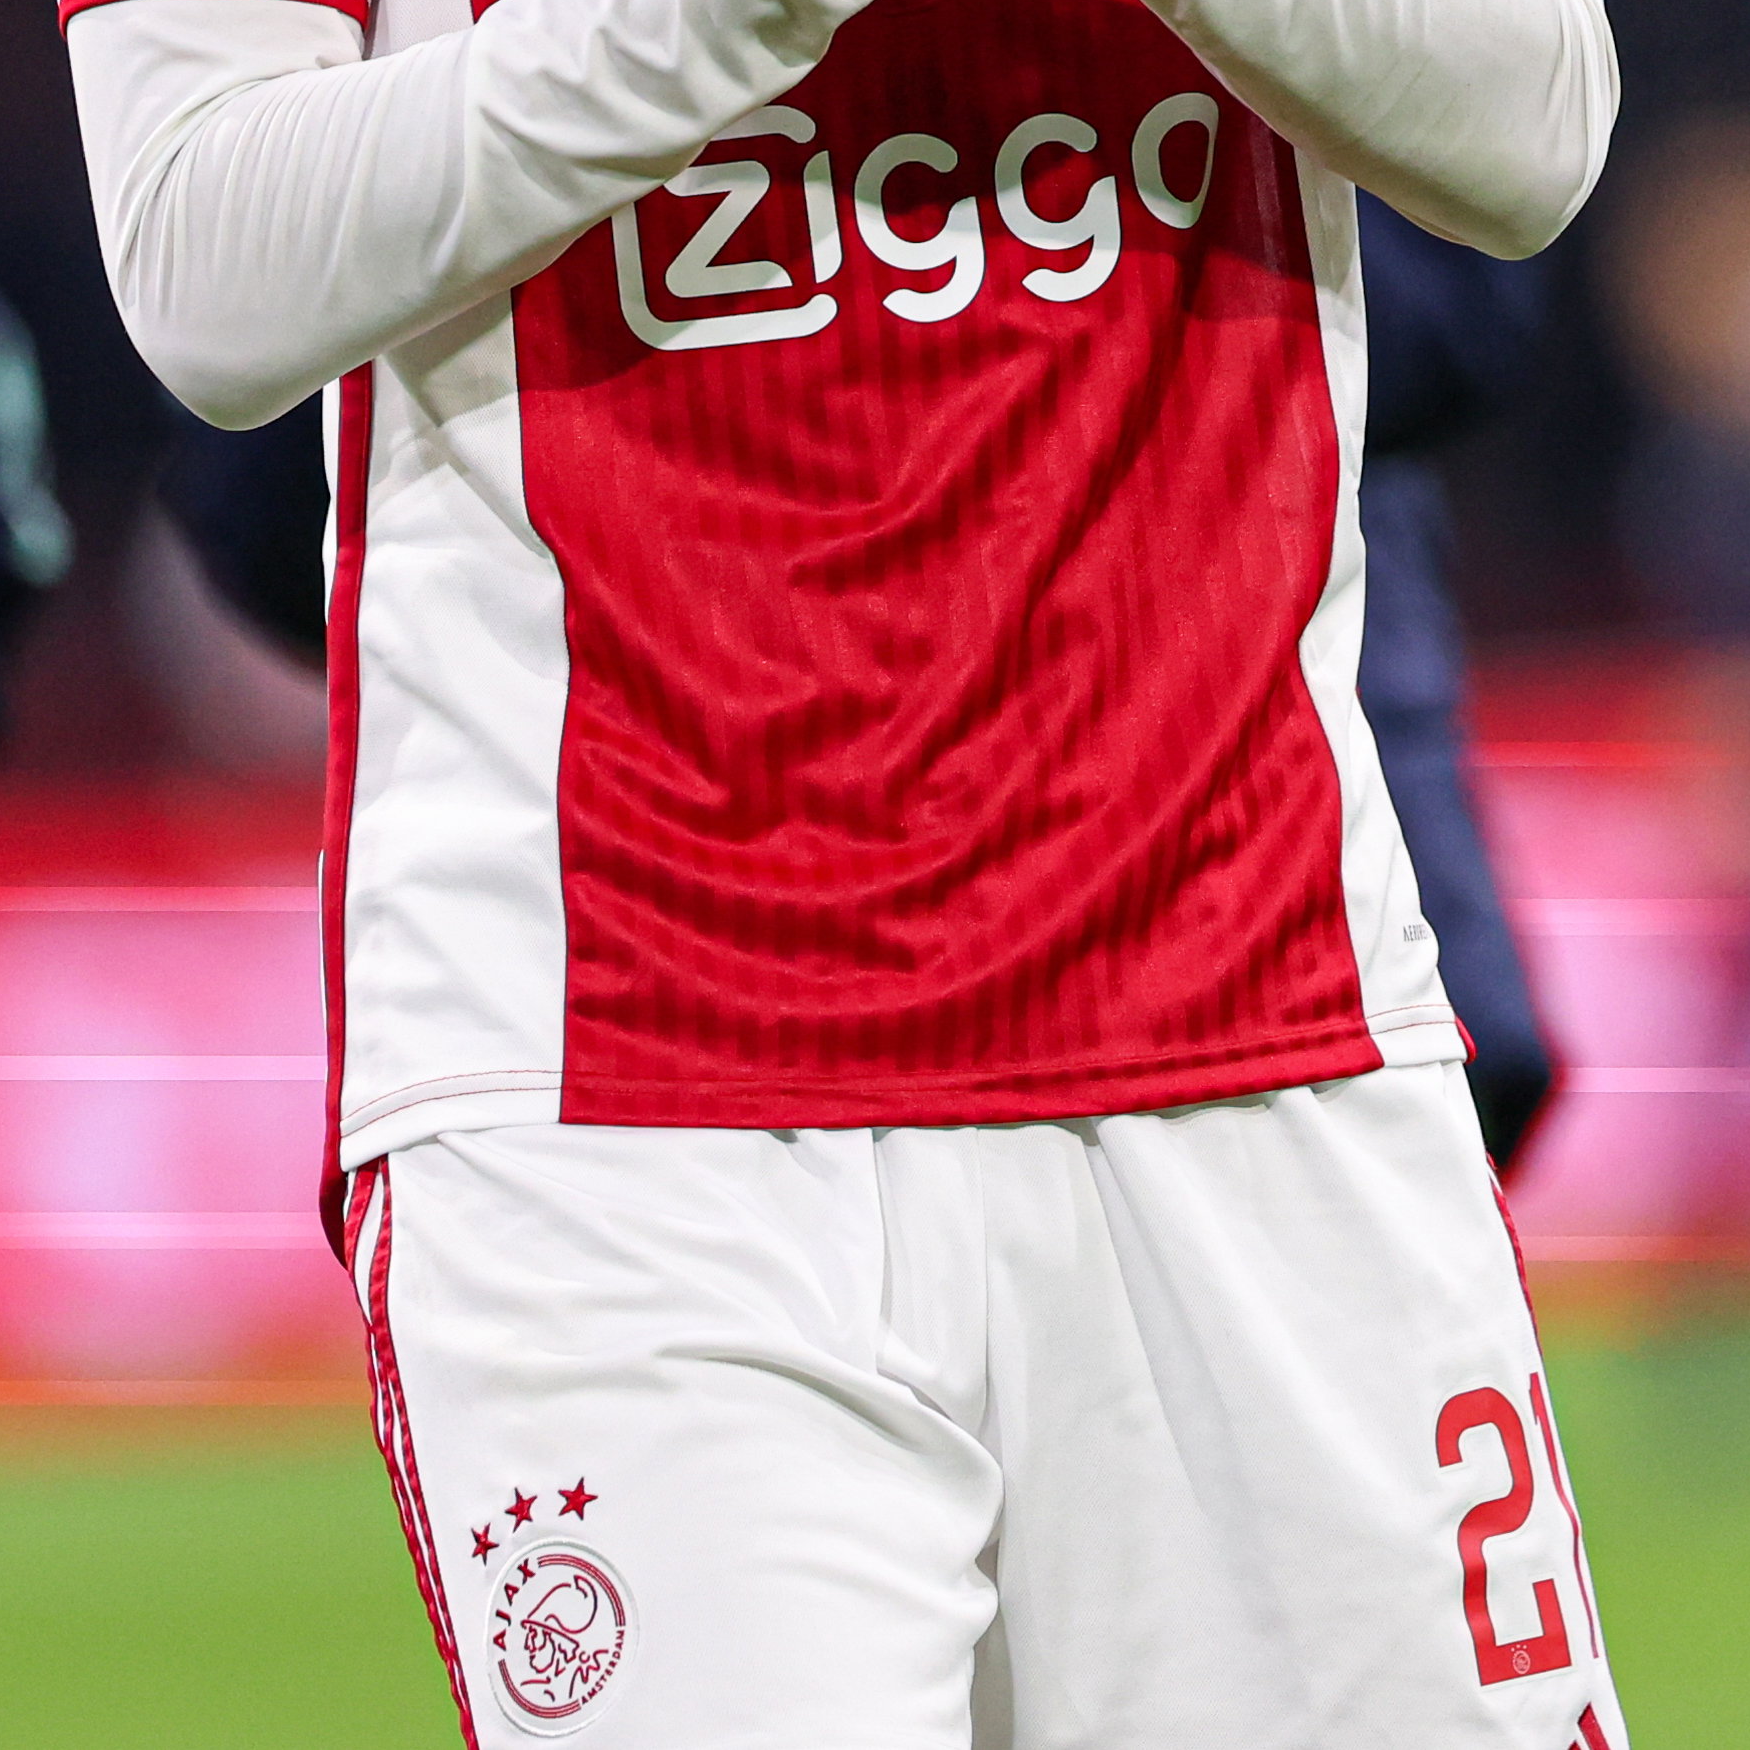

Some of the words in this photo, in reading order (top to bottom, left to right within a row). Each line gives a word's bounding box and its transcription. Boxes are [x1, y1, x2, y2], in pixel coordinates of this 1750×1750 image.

[612, 91, 1219, 351] Ziggo
[492, 1558, 537, 1652] AJAX
[1434, 1371, 1600, 1687] 21
[581, 1629, 625, 1705] AMSTERDAM
